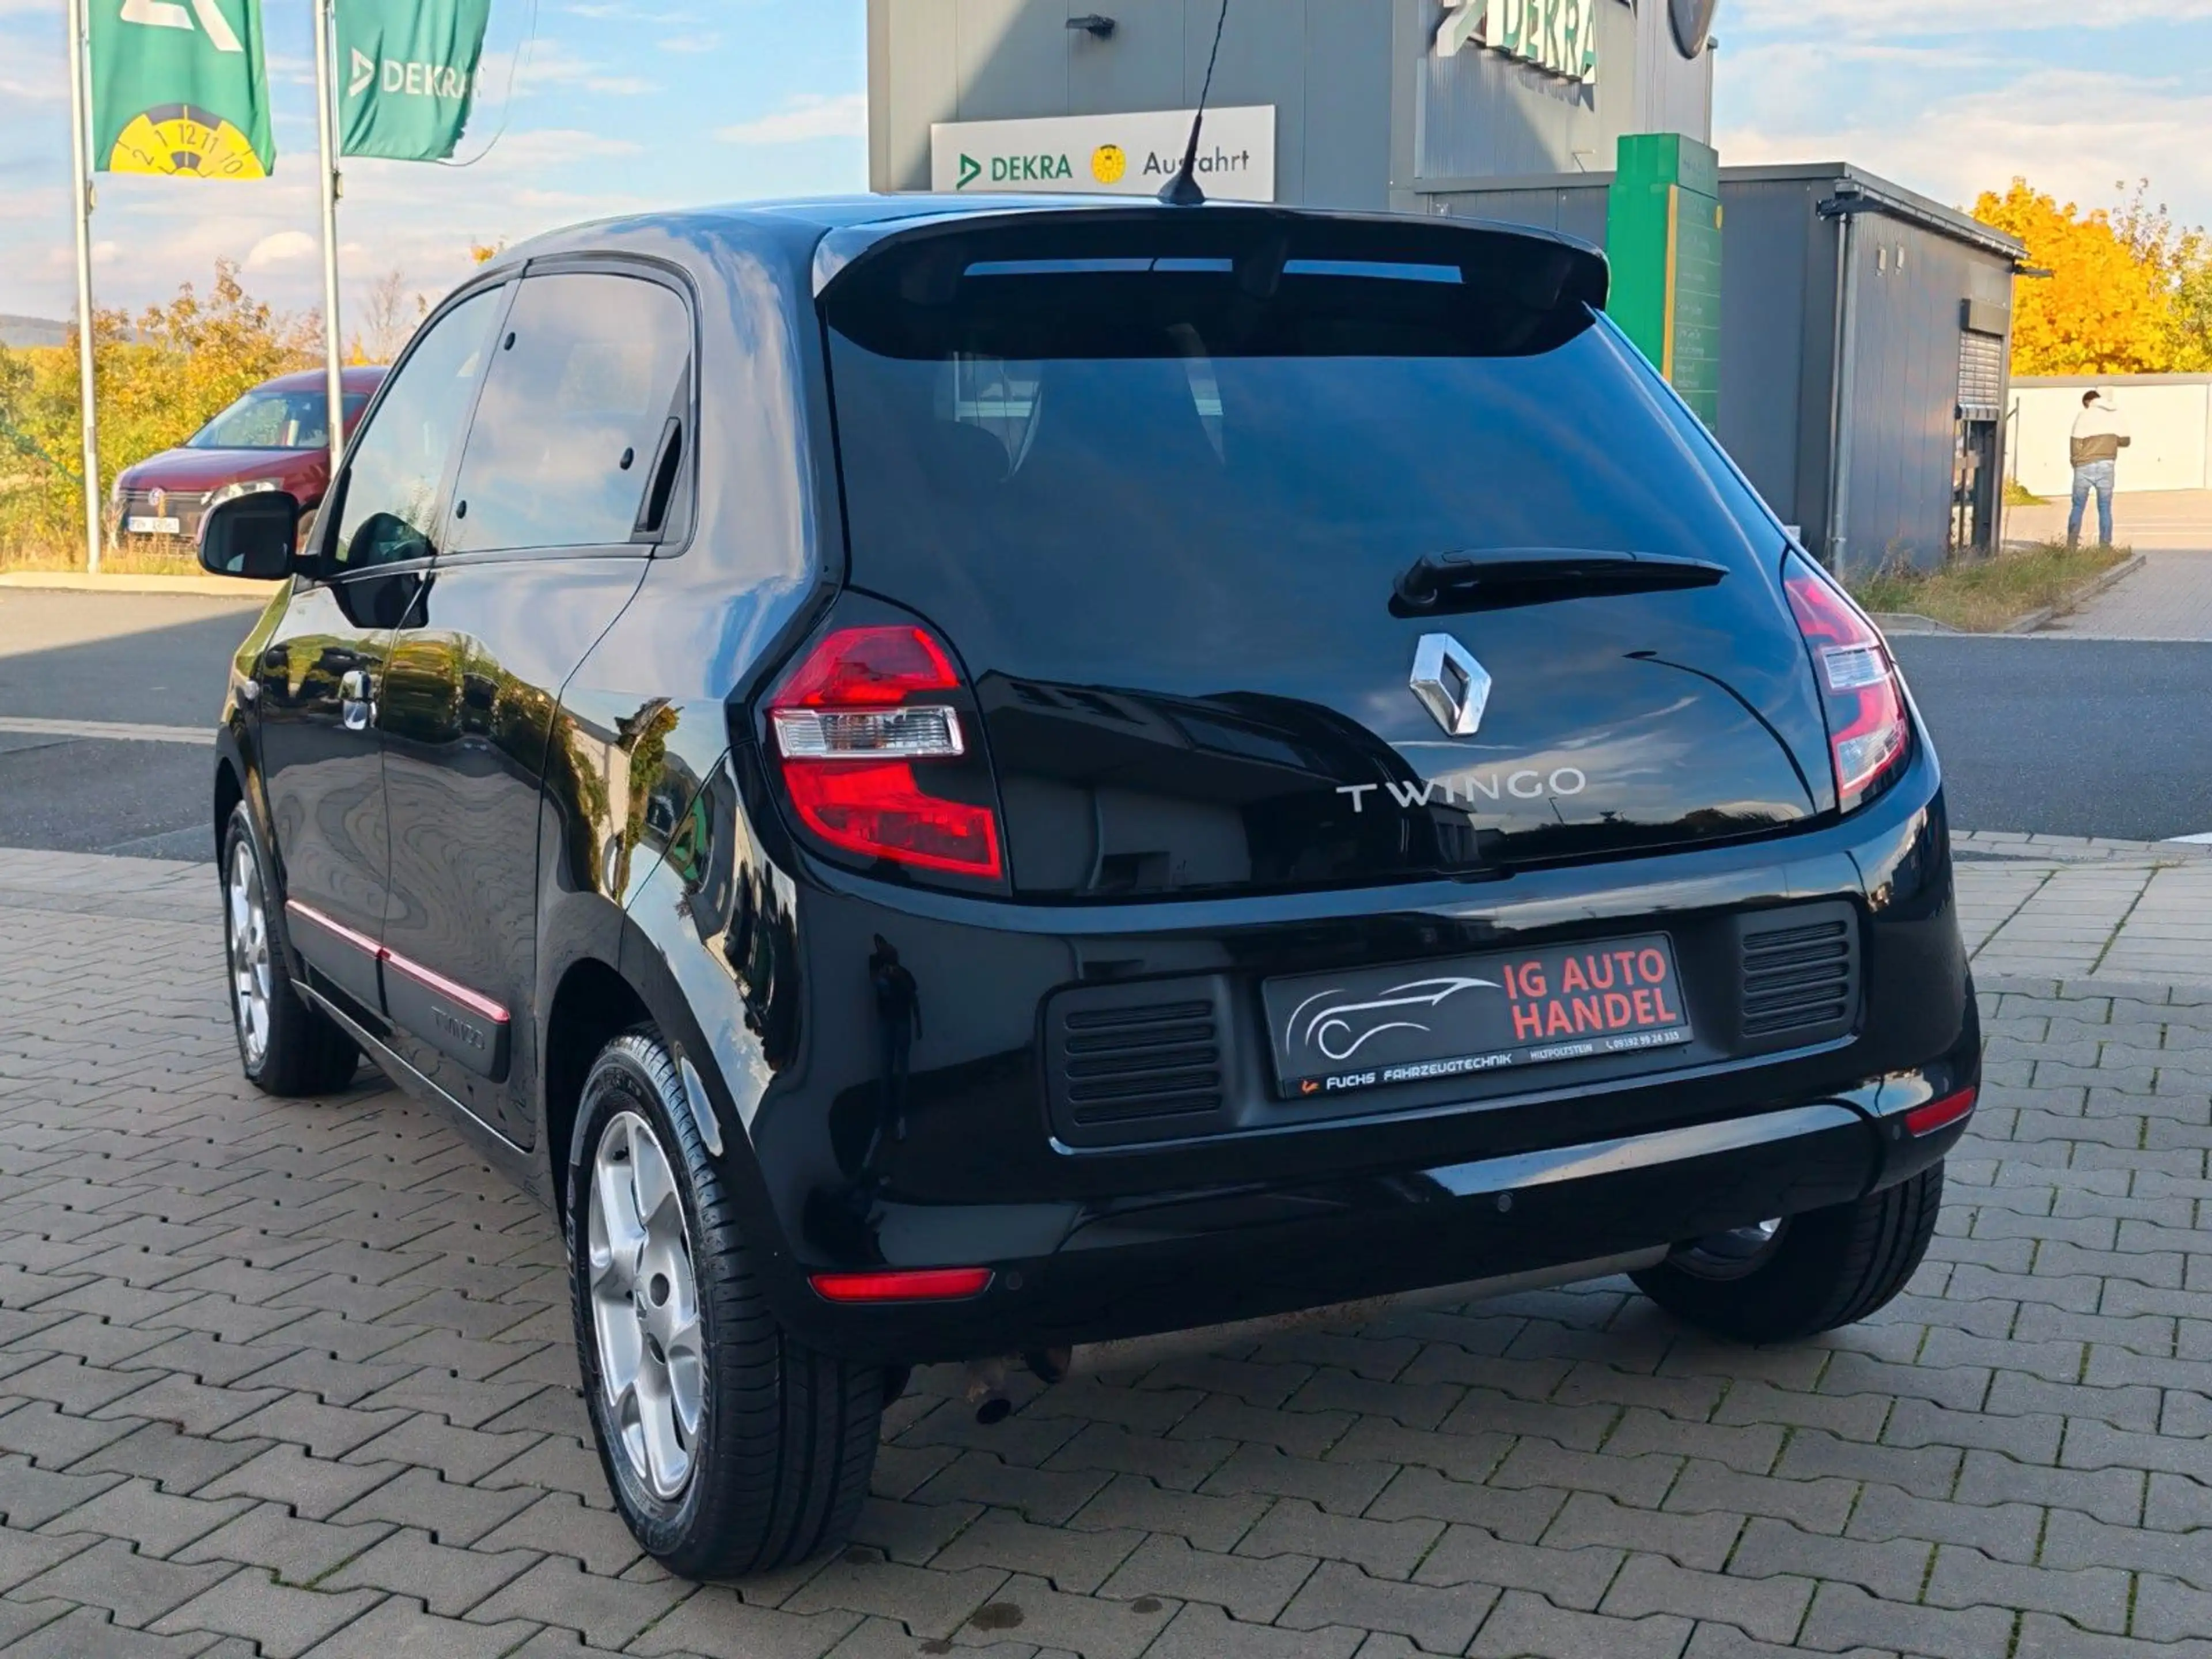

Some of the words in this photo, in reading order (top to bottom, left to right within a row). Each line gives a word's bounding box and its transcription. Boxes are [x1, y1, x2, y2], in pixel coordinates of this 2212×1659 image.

[177, 124, 196, 145] 12
[991, 154, 1073, 181] DEKRA
[1336, 767, 1586, 813] TWINGO
[1503, 961, 1547, 1000] IG
[1562, 948, 1666, 994] AUTO
[1512, 987, 1676, 1040] HANDEL
[1326, 1072, 1376, 1090] FUCHS
[1384, 1054, 1512, 1081] FAHRZEUGTECHNIK
